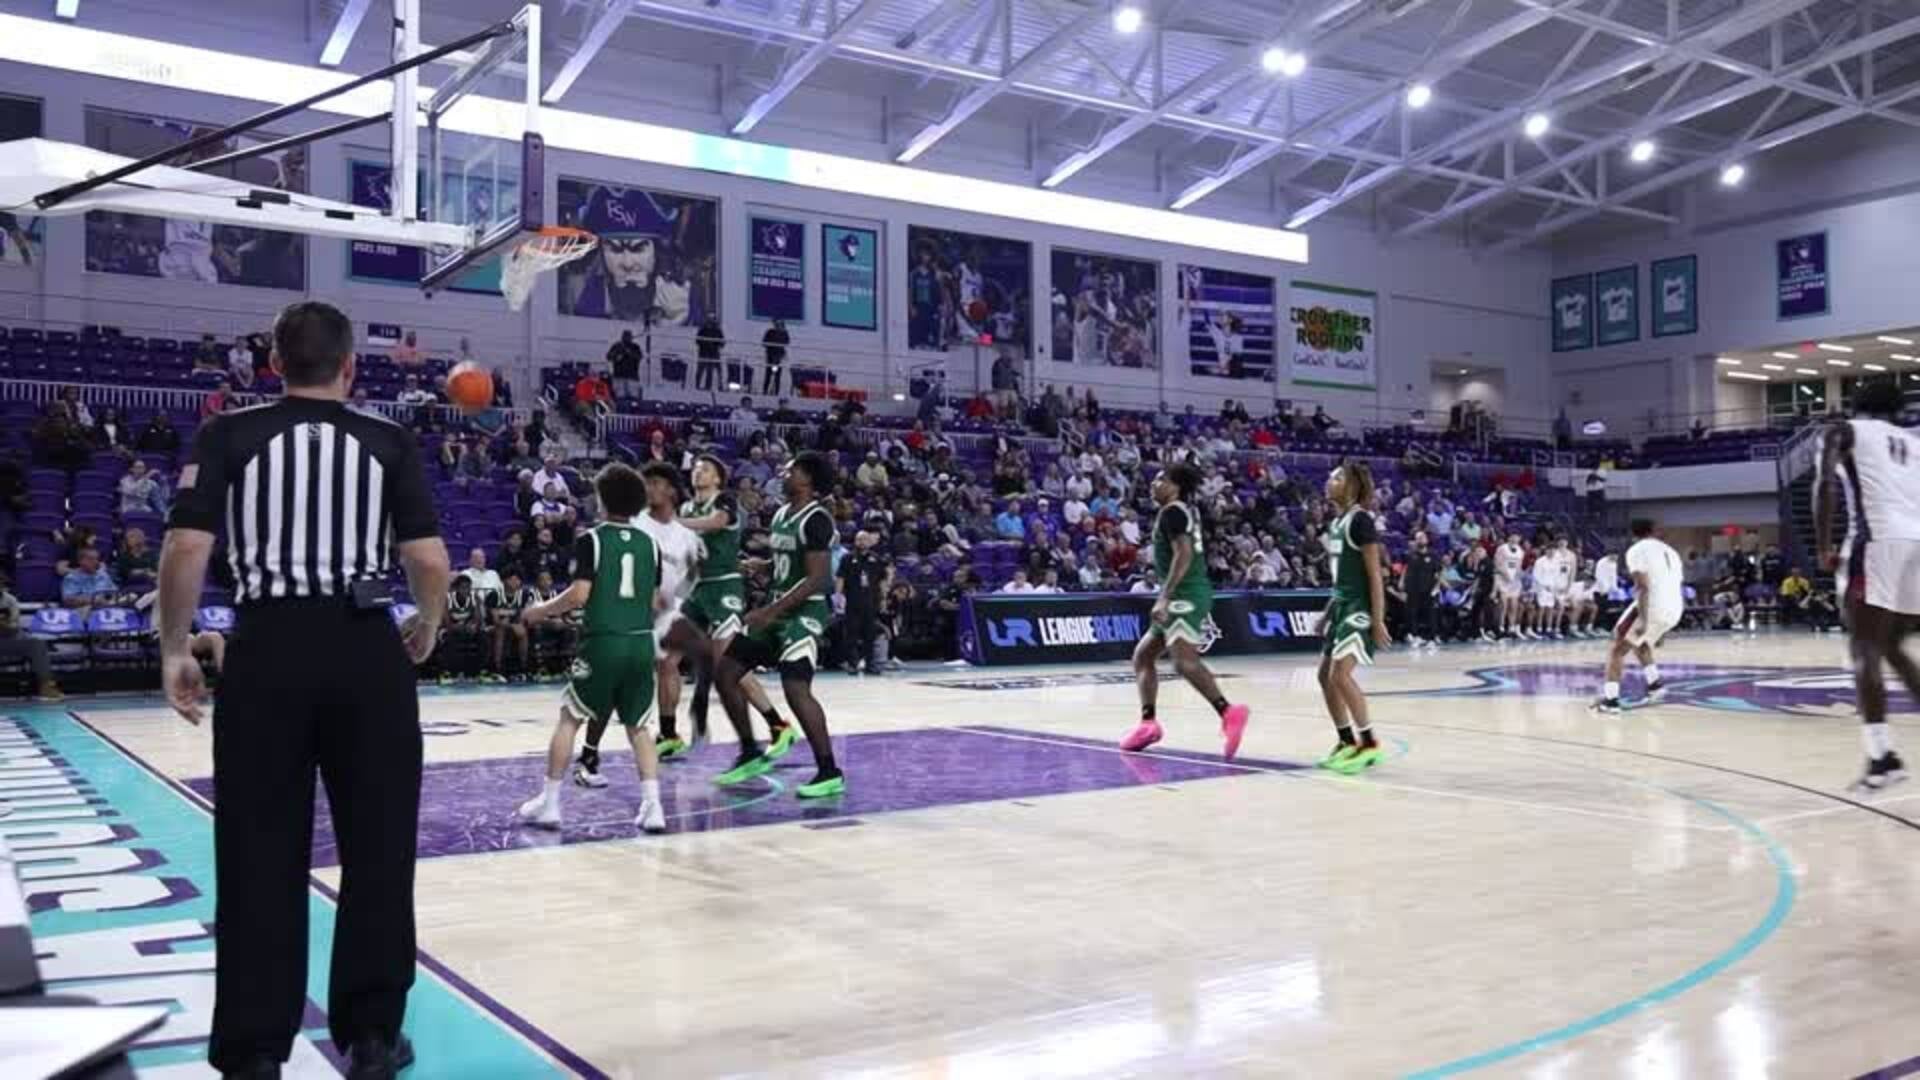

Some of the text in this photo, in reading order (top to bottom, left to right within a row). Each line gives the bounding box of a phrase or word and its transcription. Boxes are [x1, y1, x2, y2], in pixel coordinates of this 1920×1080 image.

[607, 199, 637, 227] FSW
[620, 551, 635, 598] 1
[986, 618, 1037, 647] UR
[1248, 611, 1290, 637] UR
